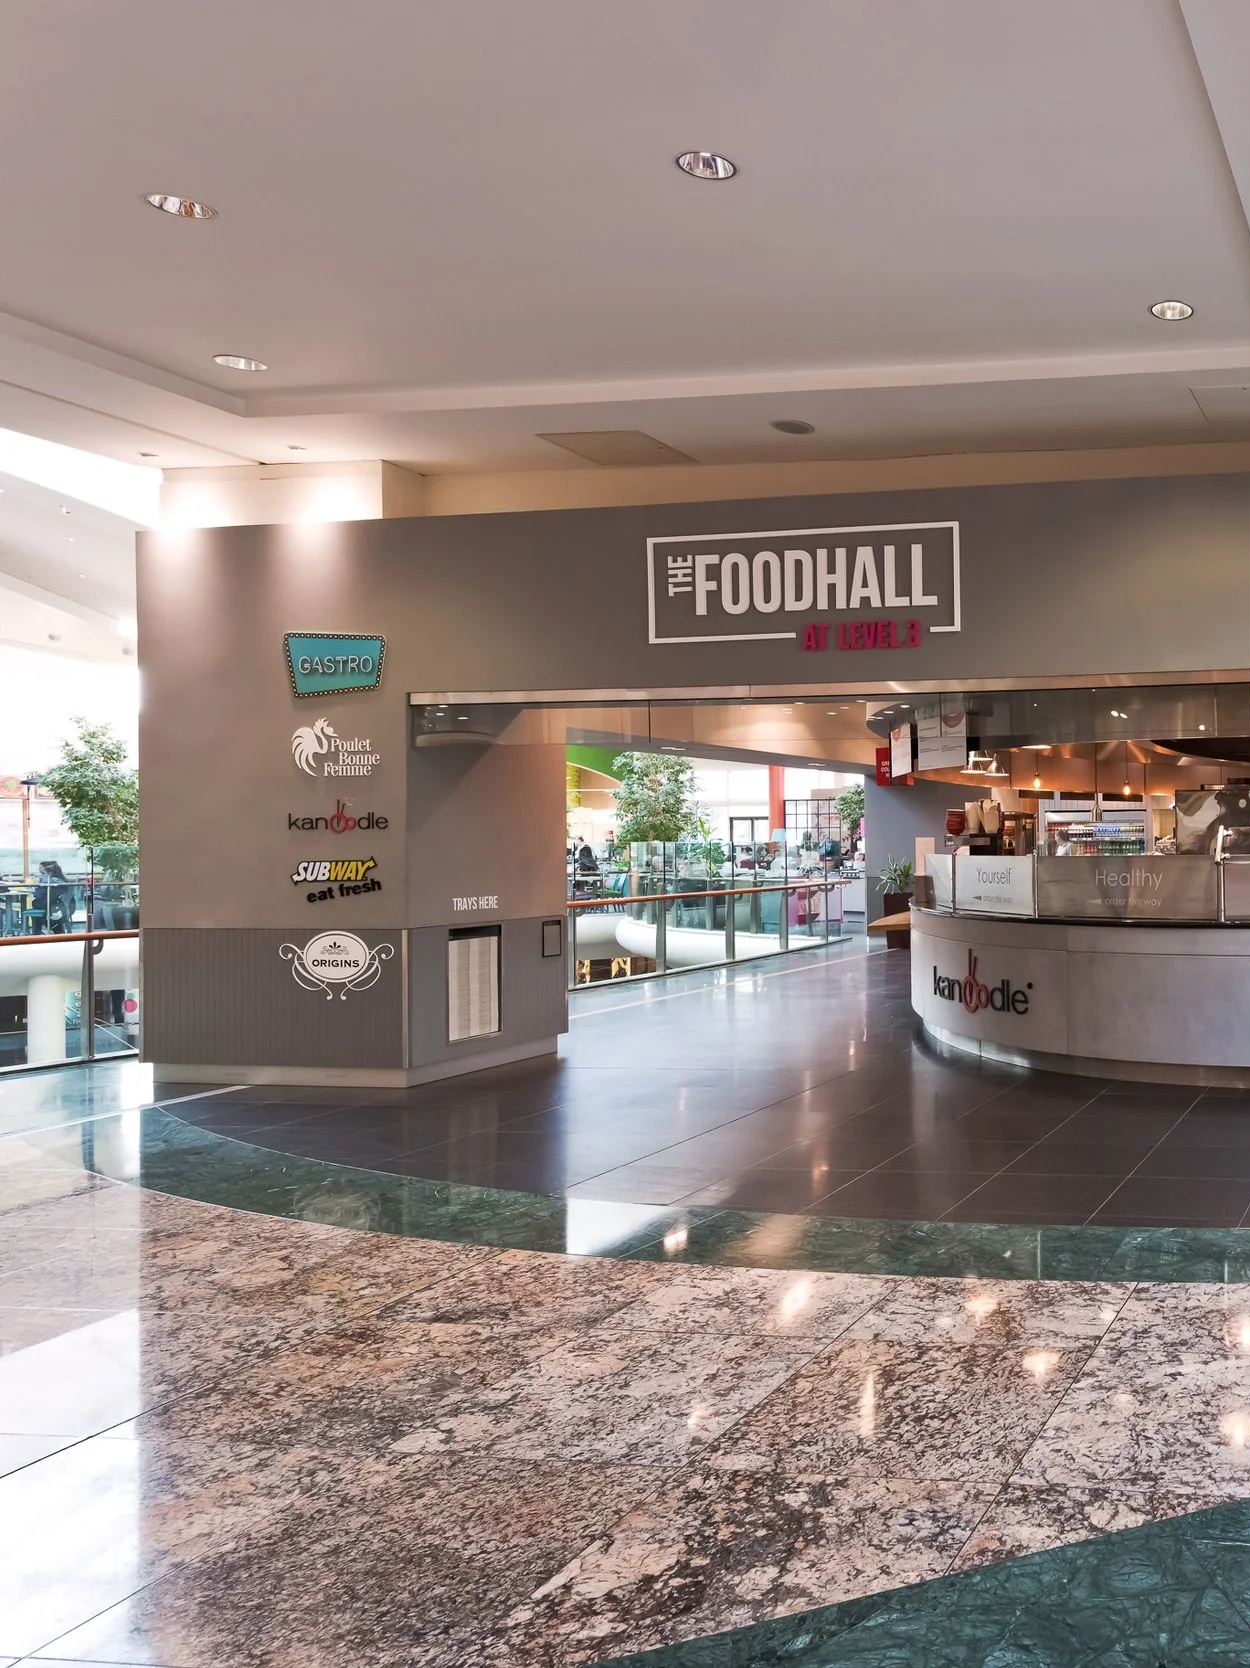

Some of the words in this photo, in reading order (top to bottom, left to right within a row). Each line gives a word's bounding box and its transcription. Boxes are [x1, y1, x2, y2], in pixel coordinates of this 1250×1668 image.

[667, 554, 694, 597] THE
[694, 543, 938, 616] FOODHALL
[803, 623, 832, 651] AT
[838, 620, 904, 650] LEVEL
[908, 619, 921, 648] 3
[298, 655, 373, 674] GASTRO
[330, 737, 372, 752] Poulet
[339, 752, 380, 765] Bonne
[323, 762, 372, 777] Femme
[288, 809, 389, 834] kanoodle
[291, 856, 377, 885] SUBWAY
[976, 867, 1013, 886] Yourself
[1095, 868, 1163, 891] Healthy
[307, 887, 335, 903] eat
[452, 896, 478, 911] TRAYS
[478, 895, 498, 909] HERE
[1104, 897, 1126, 905] order
[1143, 898, 1162, 908] way
[311, 959, 360, 969] ORIGINS
[933, 960, 1030, 1015] kanoodle
